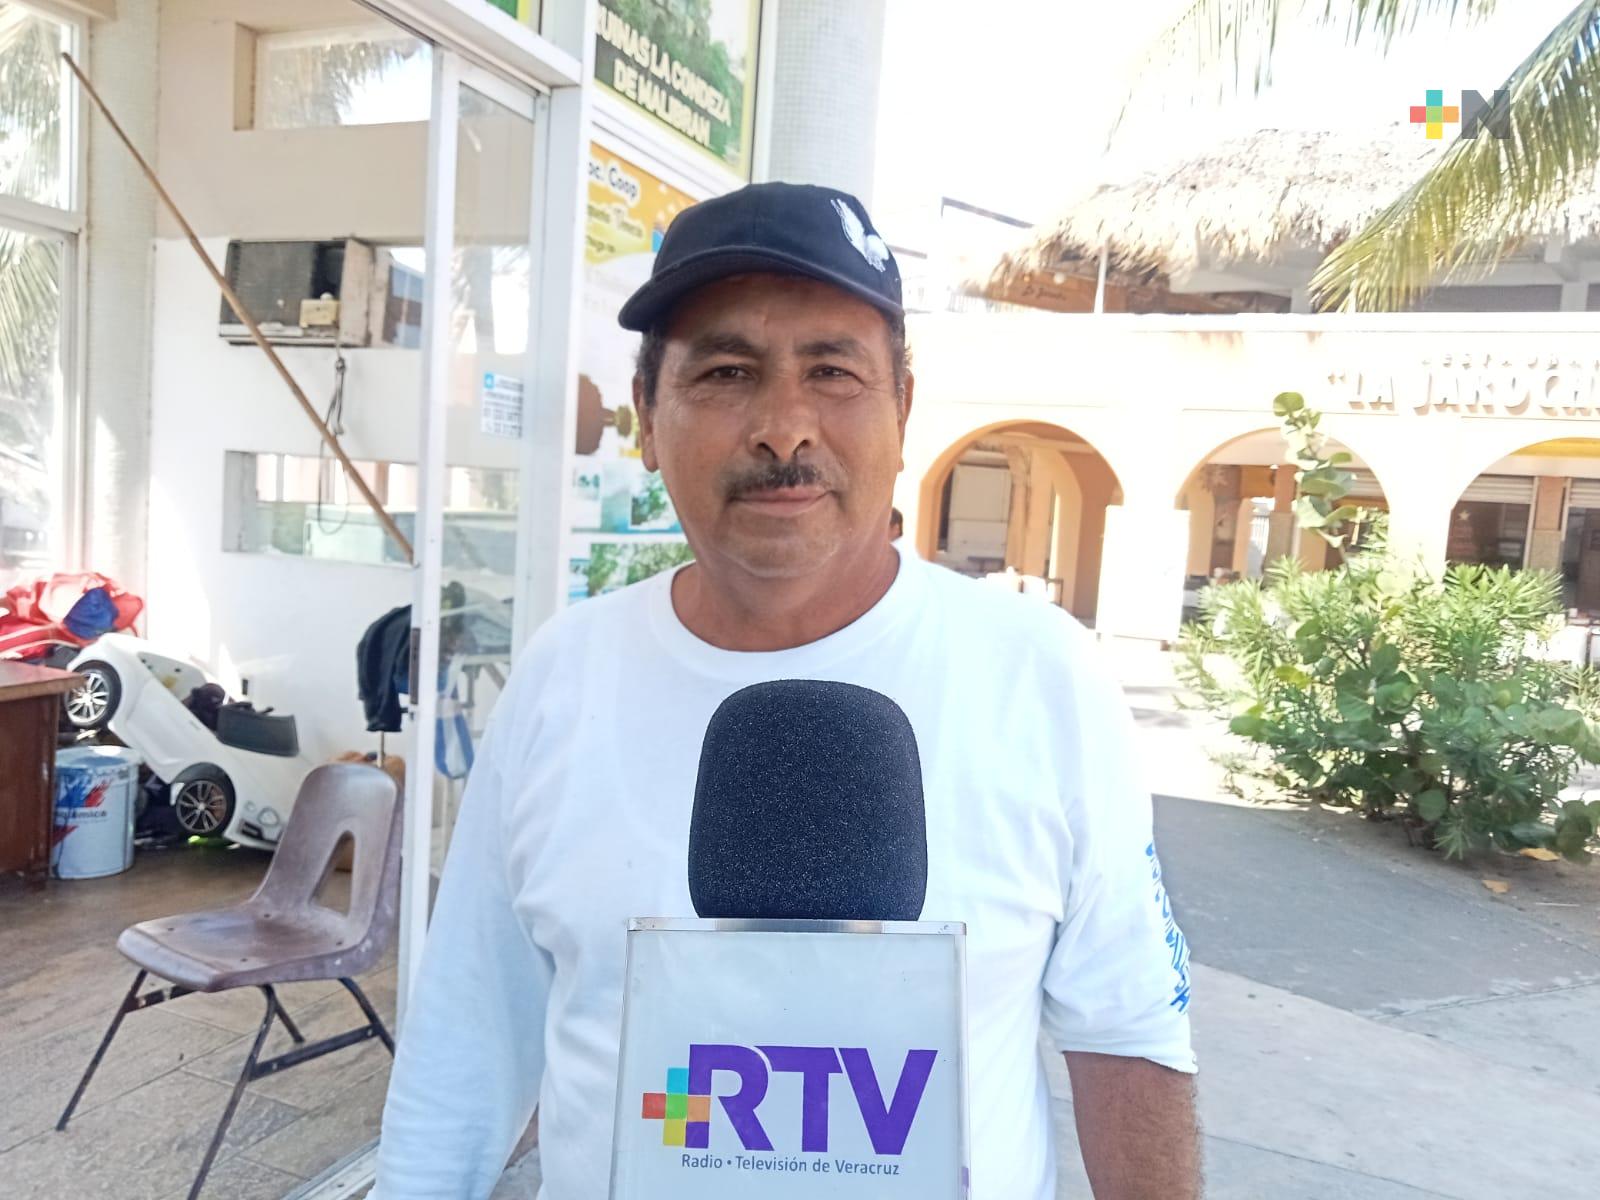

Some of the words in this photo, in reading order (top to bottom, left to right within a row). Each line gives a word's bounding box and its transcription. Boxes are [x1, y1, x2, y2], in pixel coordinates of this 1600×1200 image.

[613, 58, 637, 101] DE
[650, 44, 671, 84] LA
[1413, 373, 1600, 416] JAROCH
[685, 1044, 938, 1155] RTV
[681, 1153, 723, 1169] Radio
[735, 1155, 807, 1172] Televisión
[812, 1158, 831, 1173] de
[835, 1159, 900, 1176] Veracruz
